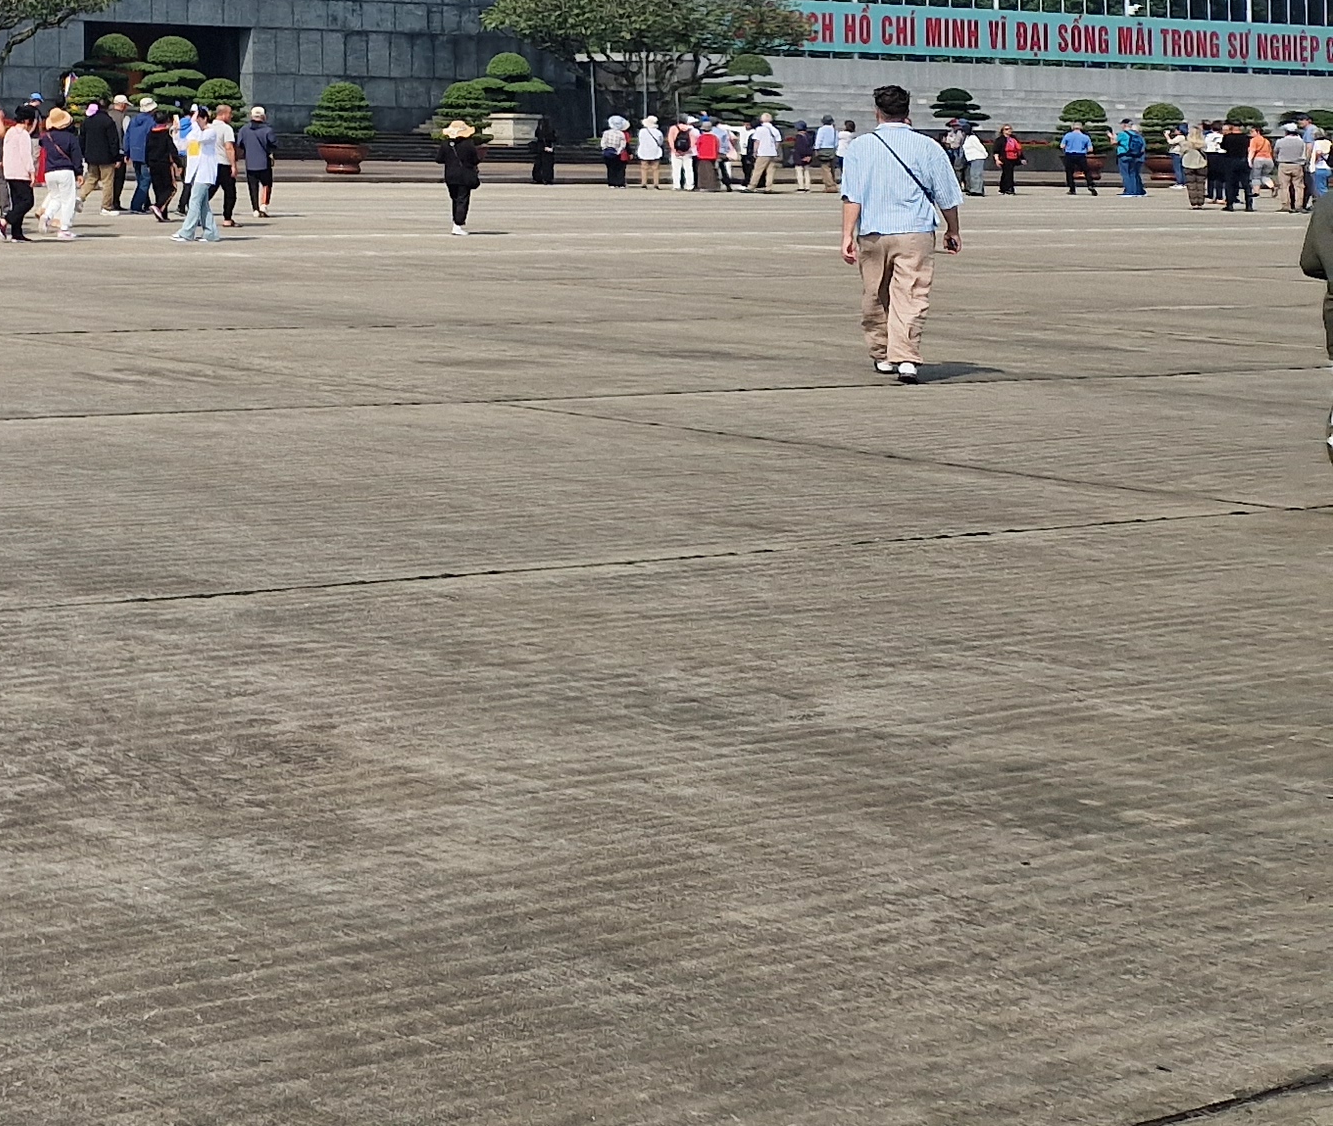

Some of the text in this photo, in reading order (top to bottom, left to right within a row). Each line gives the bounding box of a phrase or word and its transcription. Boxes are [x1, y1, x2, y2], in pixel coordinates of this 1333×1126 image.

[844, 3, 872, 44] HỒ
[881, 10, 916, 47] CHÍ
[925, 17, 980, 49] MINH
[988, 15, 1008, 50] VĨ
[1015, 21, 1049, 57] ĐẠI
[1058, 14, 1110, 54] SỐNG
[1117, 21, 1153, 56] MÃI
[1159, 28, 1220, 59] TRONG
[1227, 28, 1252, 64] SỰ
[1256, 29, 1320, 67] NGHIỆP
